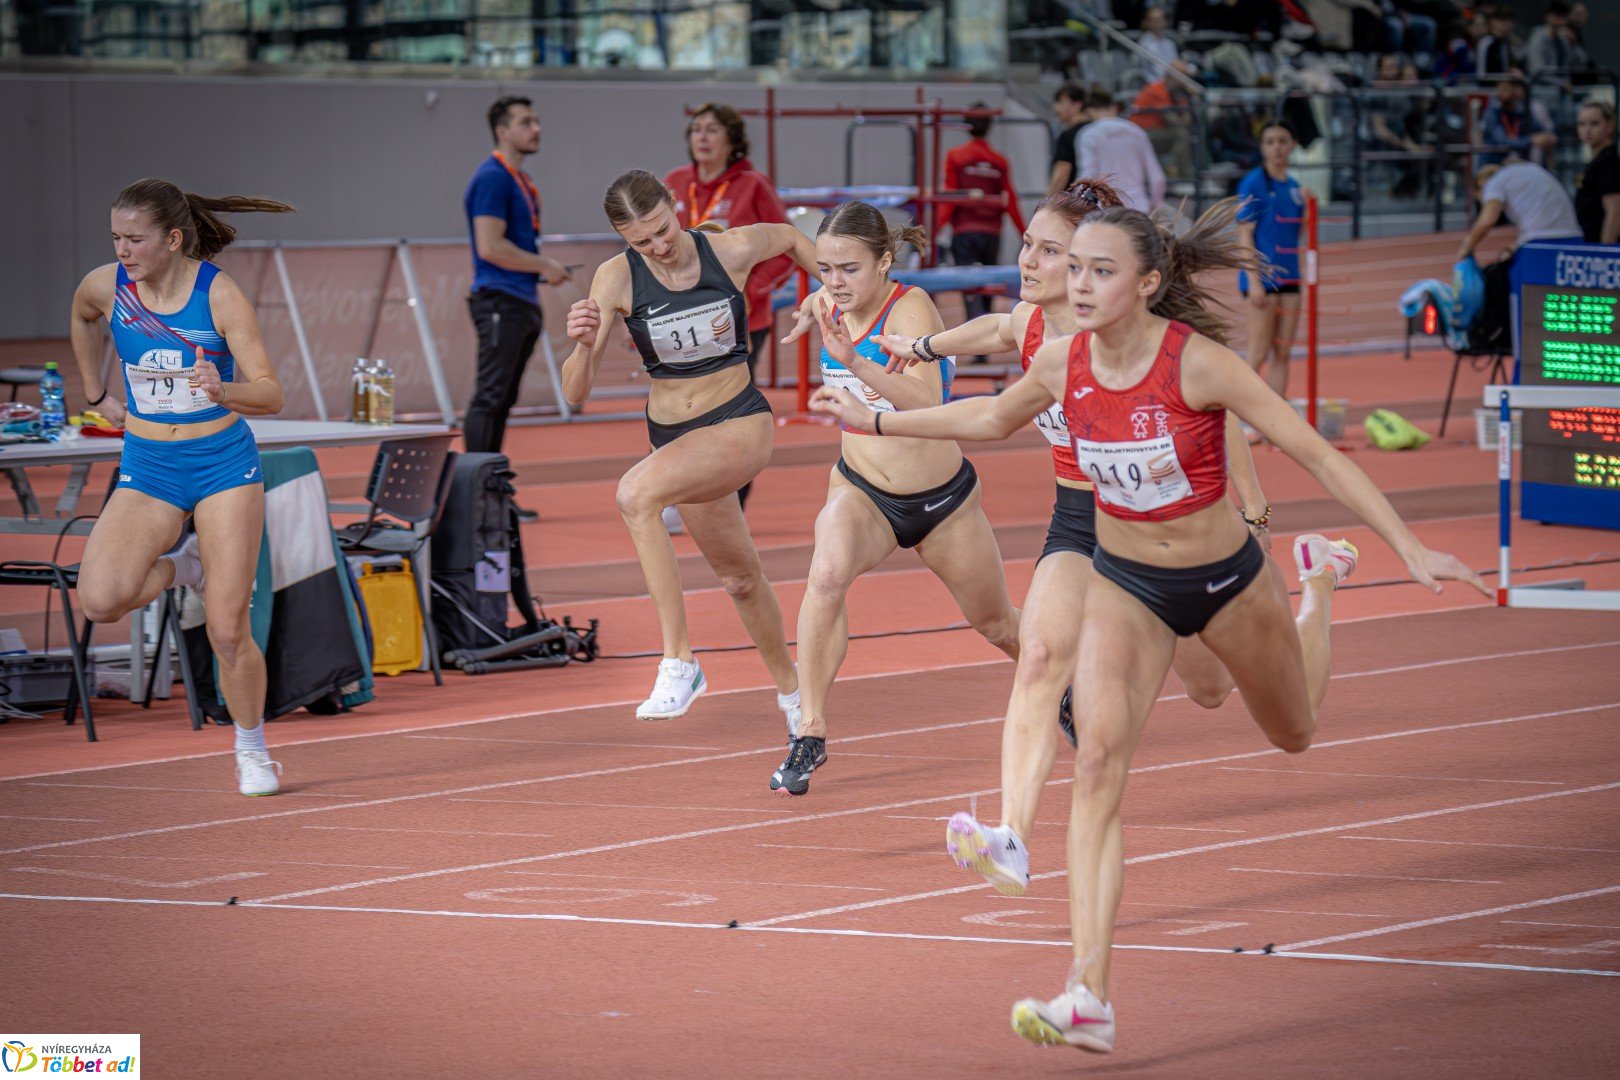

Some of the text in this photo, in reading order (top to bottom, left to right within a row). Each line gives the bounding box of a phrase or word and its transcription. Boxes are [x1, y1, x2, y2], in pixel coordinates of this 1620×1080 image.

[652, 317, 674, 327] HALOVÉ
[675, 306, 720, 321] MAJSTROVSTVÁ
[670, 326, 700, 350] 31
[146, 377, 174, 396] 79
[1090, 462, 1142, 491] 219
